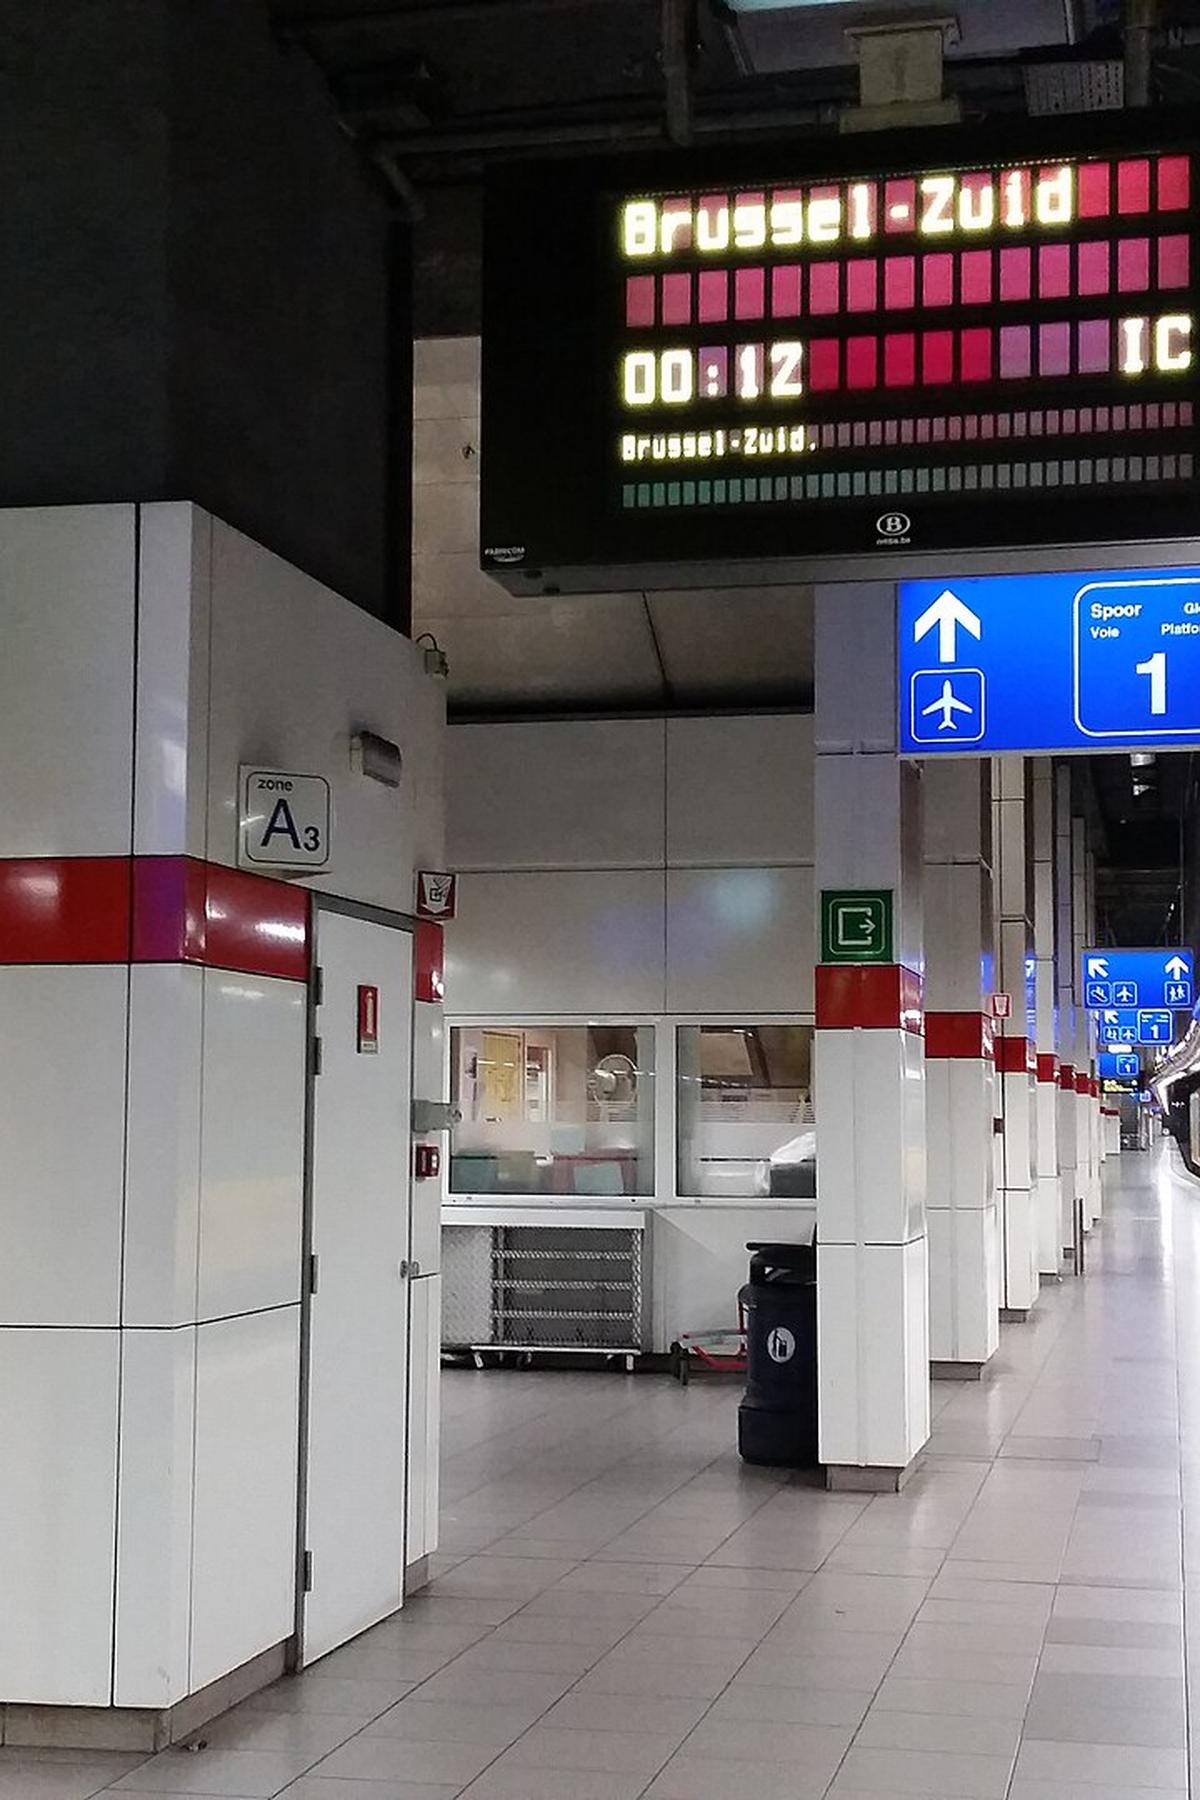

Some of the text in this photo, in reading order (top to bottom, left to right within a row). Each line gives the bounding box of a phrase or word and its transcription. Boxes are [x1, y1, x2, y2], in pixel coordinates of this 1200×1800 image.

[624, 166, 1073, 256] Brussel-Zuid
[624, 316, 1192, 404] 00:12 IC
[1090, 602, 1143, 621] Spoor
[1089, 625, 1120, 639] Voie
[1136, 652, 1166, 714] 1
[257, 778, 294, 792] zone
[1150, 1024, 1159, 1039] 1
